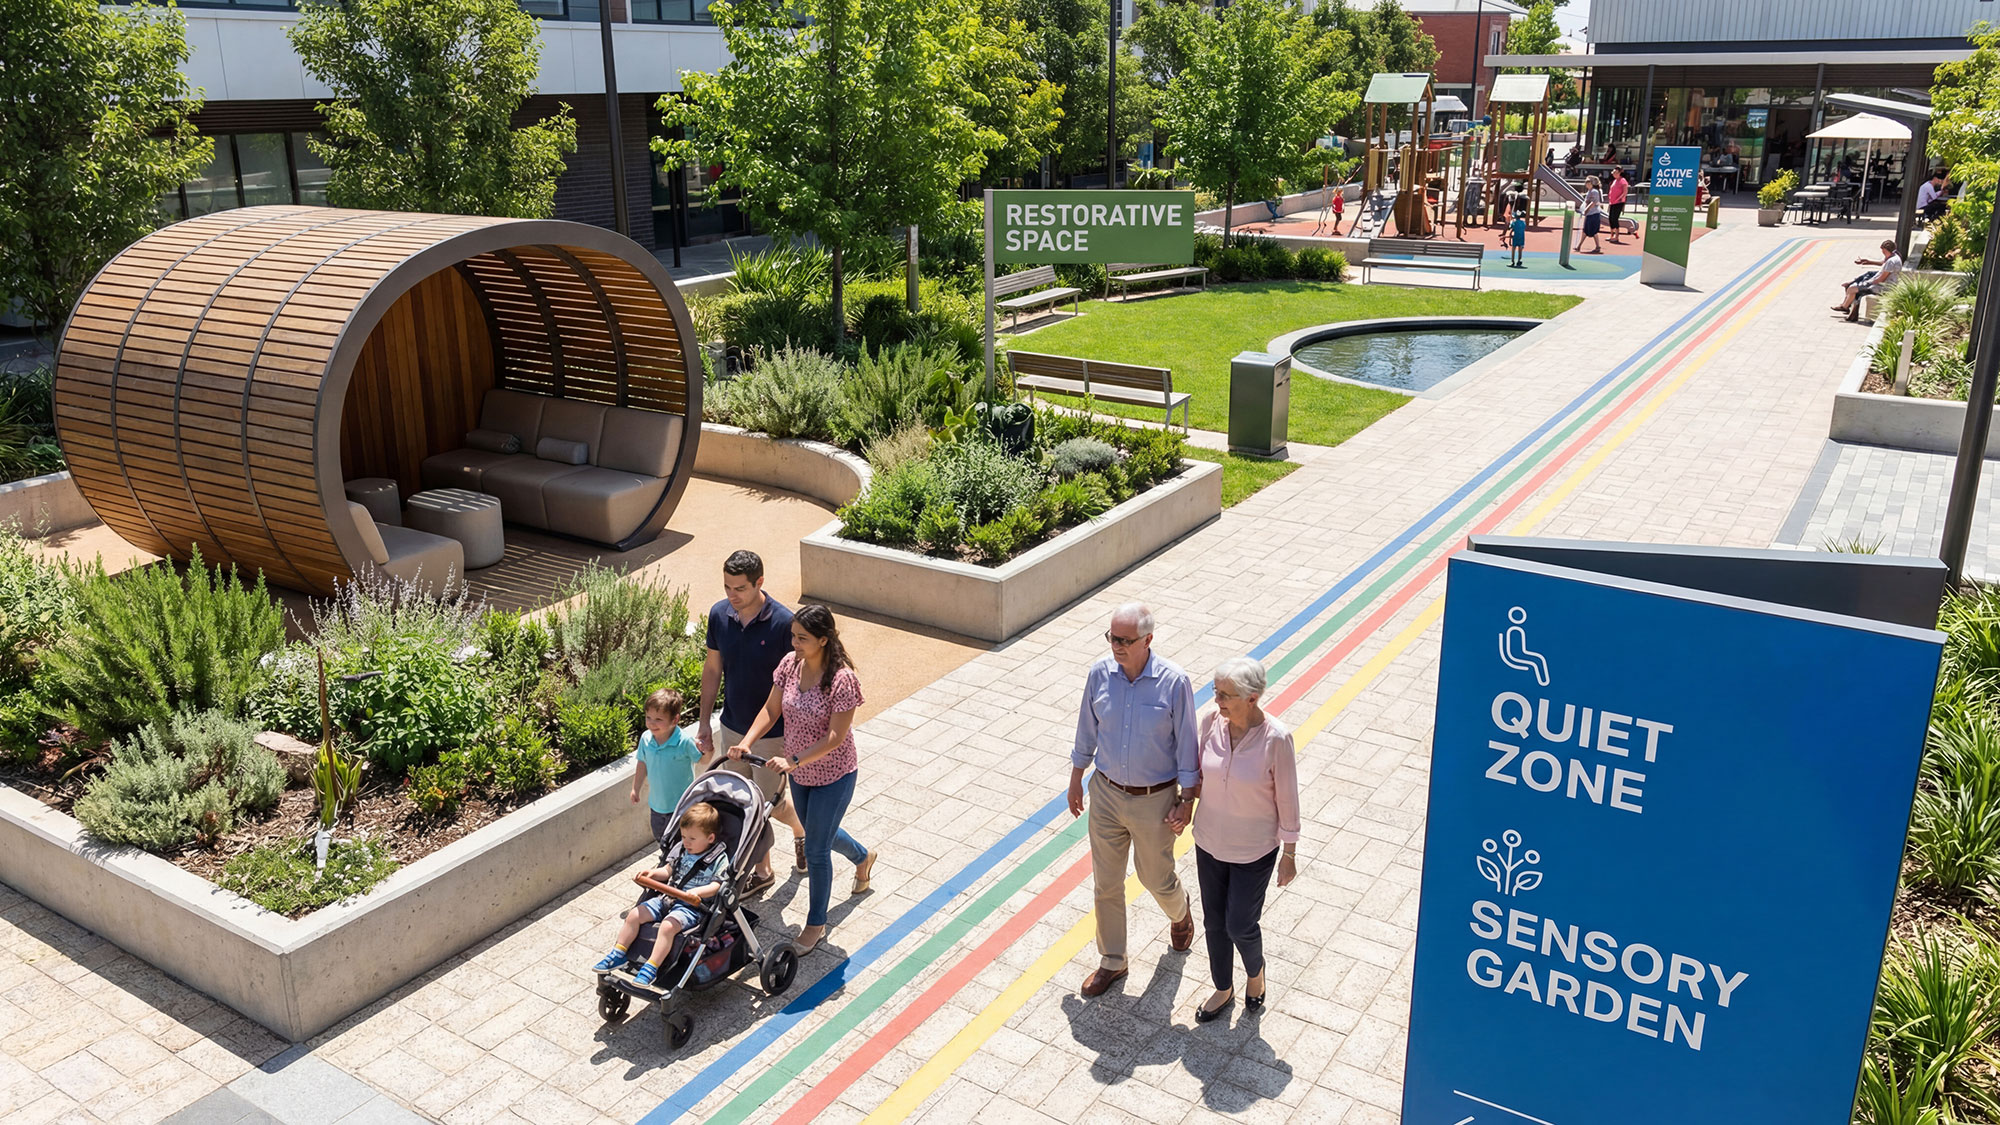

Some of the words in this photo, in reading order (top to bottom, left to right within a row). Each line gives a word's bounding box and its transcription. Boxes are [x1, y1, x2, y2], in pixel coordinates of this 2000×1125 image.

[1655, 178, 1683, 188] ZONE
[1656, 168, 1693, 178] ACTIVE
[1006, 204, 1183, 226] RESTORATIVE
[1005, 229, 1089, 252] SPACE
[1490, 691, 1674, 763] QUIET
[1485, 740, 1646, 814] ZONE
[1469, 900, 1749, 1008] SENSORY
[1466, 948, 1706, 1051] GARDEN
